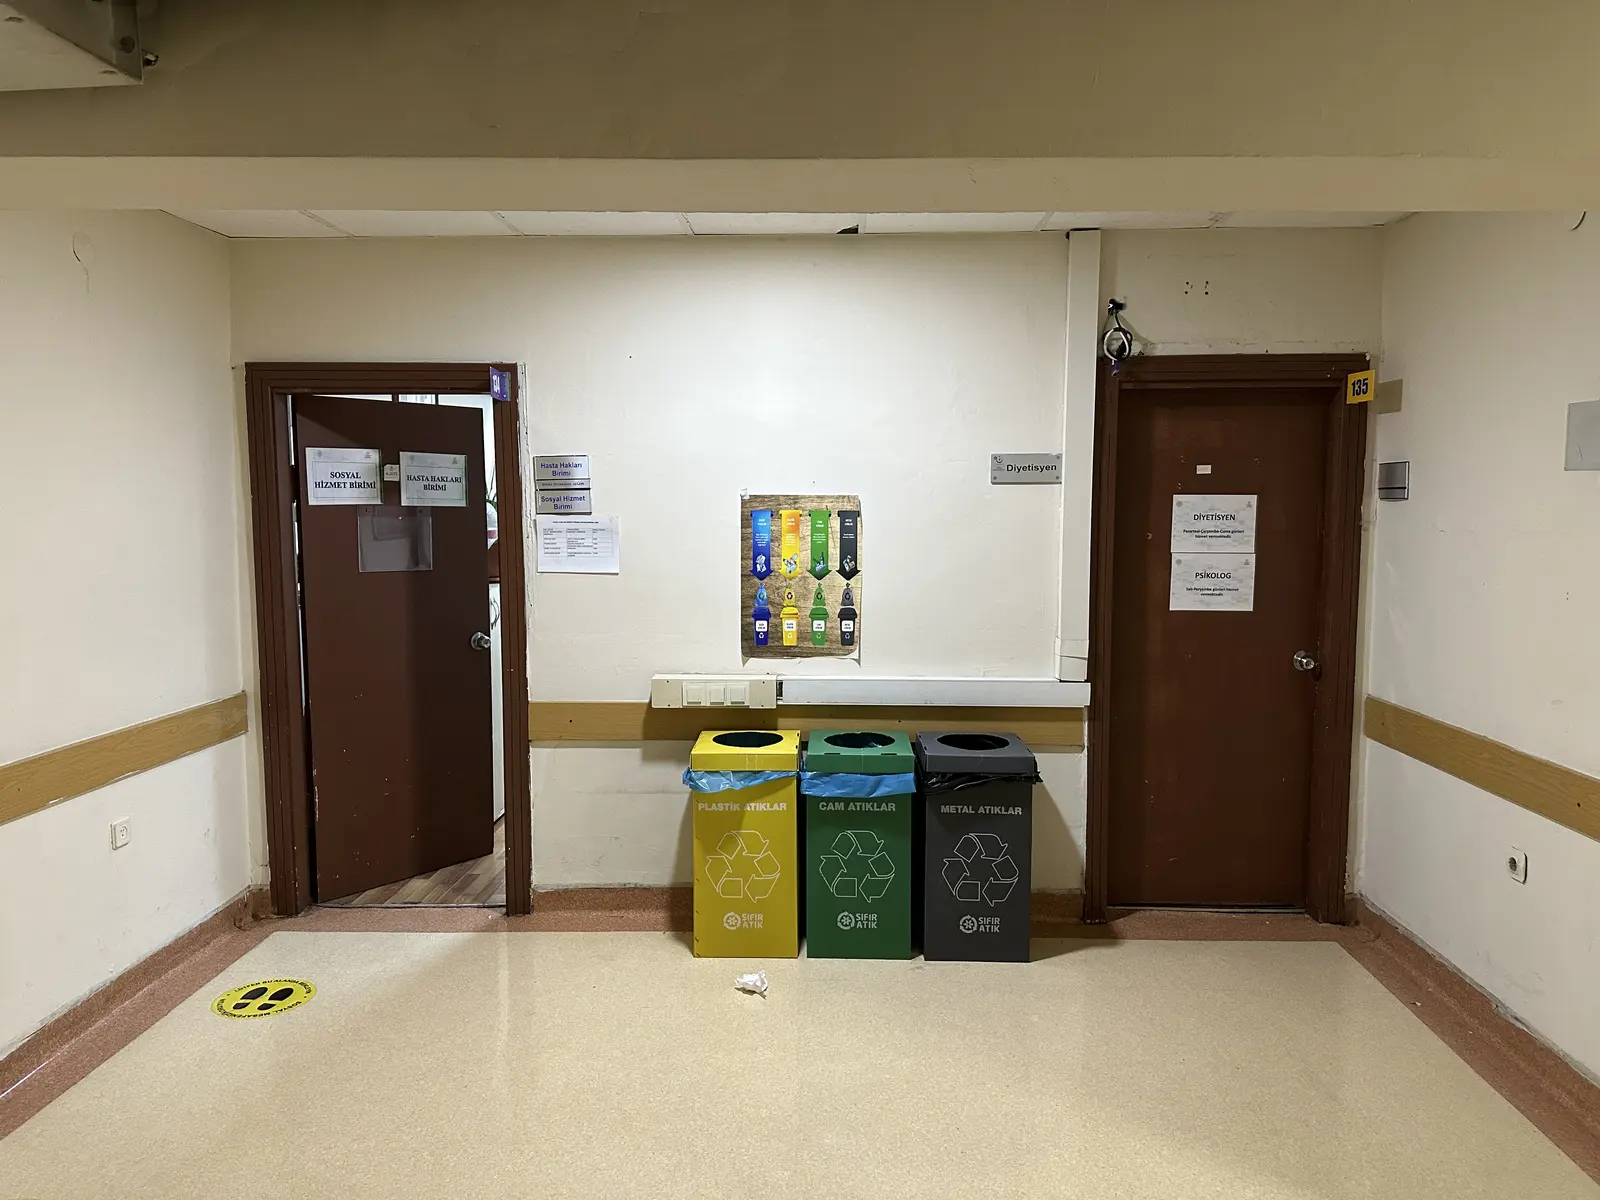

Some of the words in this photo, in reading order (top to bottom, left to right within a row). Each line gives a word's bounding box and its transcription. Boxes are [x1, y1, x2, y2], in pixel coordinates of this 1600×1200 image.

[1351, 378, 1369, 396] 135
[1006, 464, 1057, 473] Diyetisyen
[314, 480, 348, 488] HİZMET
[349, 480, 376, 489] BİRİMİ
[424, 483, 447, 491] BİRİMİ
[1195, 571, 1232, 579] PSİKOLOG
[698, 801, 740, 811] PLASTİK
[744, 802, 787, 811] ATIKLAR
[818, 802, 844, 811] CAM
[848, 802, 896, 811] ATIKLAR
[940, 805, 975, 813] METAL
[978, 806, 1022, 815] ATIKLAR
